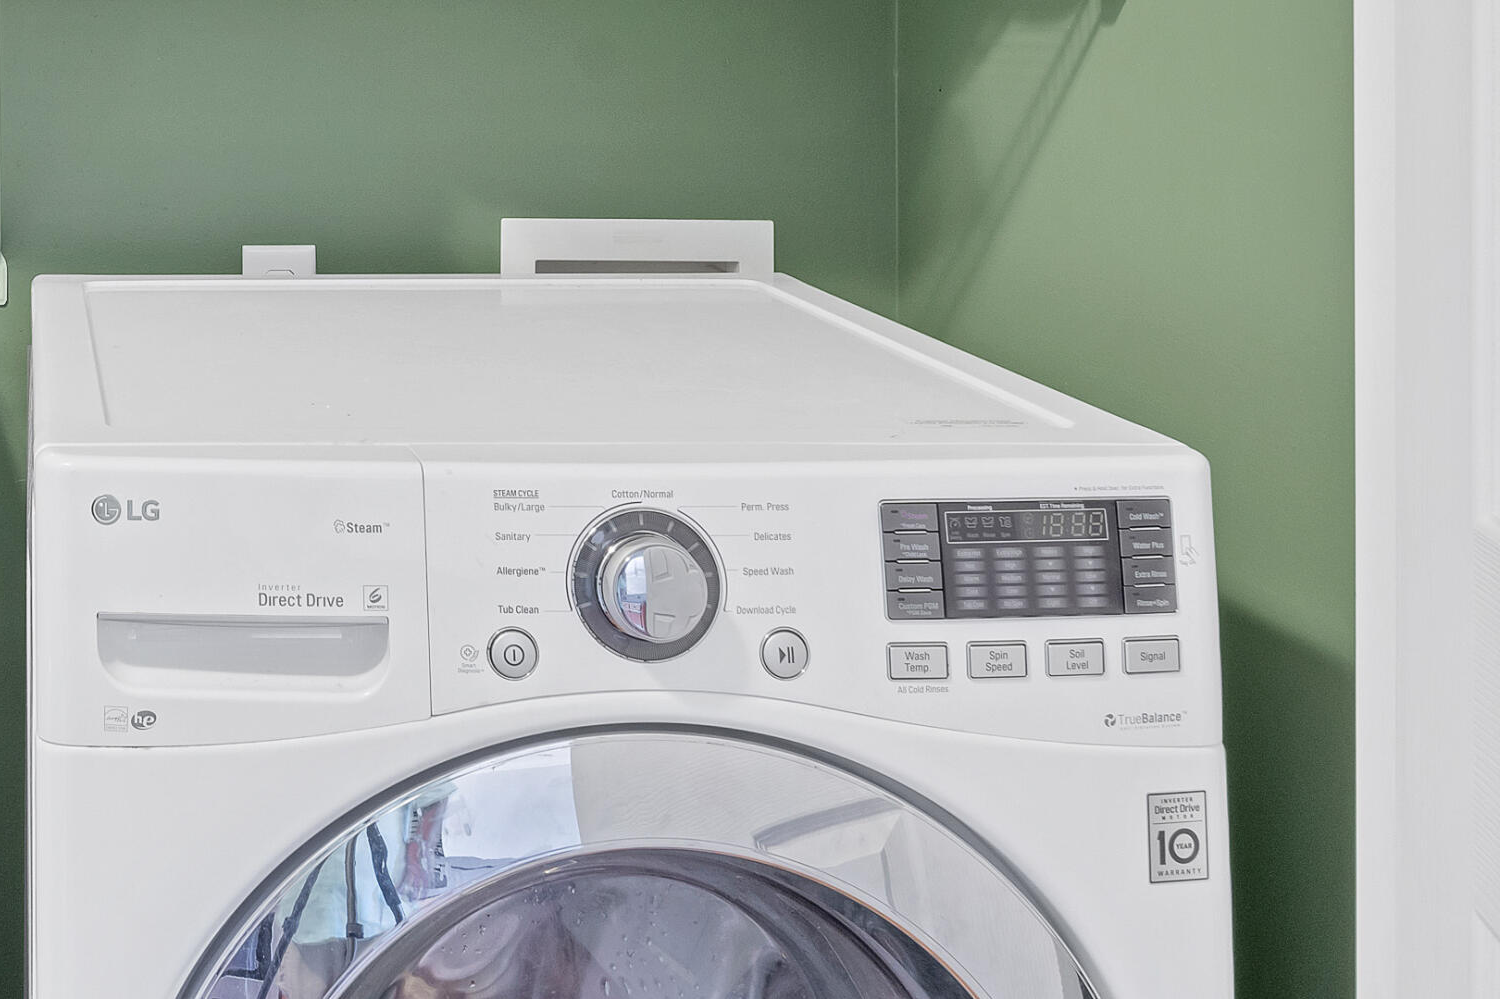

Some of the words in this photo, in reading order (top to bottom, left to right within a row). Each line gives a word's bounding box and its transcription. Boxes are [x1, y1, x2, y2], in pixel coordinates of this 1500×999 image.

[611, 490, 674, 499] Cotton/Normal
[126, 500, 160, 521] LG
[493, 502, 546, 512] Bulky/Large
[741, 502, 764, 511] Perm.
[766, 502, 790, 511] Press
[494, 532, 531, 542] Sanitary
[754, 532, 792, 541] Delicates
[742, 567, 769, 577] Speed
[770, 567, 794, 576] Wash
[1134, 571, 1150, 579] Extra
[898, 576, 915, 584] Delay
[258, 583, 302, 592] Inverter
[258, 593, 302, 608] Direct
[306, 593, 344, 608] Drive
[498, 605, 515, 614] Tub
[516, 605, 540, 614] Clean
[736, 606, 774, 614] Download
[776, 606, 796, 615] Cycle
[904, 651, 930, 661] Wash
[988, 650, 1009, 662] Spin
[1069, 649, 1086, 659] Soil
[1140, 651, 1166, 663] Signal
[904, 662, 932, 674] Temp.
[985, 662, 1013, 673] Speed
[1066, 660, 1090, 670] Level
[908, 686, 924, 694] Cold
[925, 684, 949, 693] Rinses
[1154, 805, 1178, 814] Direct
[1180, 804, 1200, 814] Drive
[1156, 828, 1200, 866] 10
[1157, 868, 1202, 877] WARRANTY
